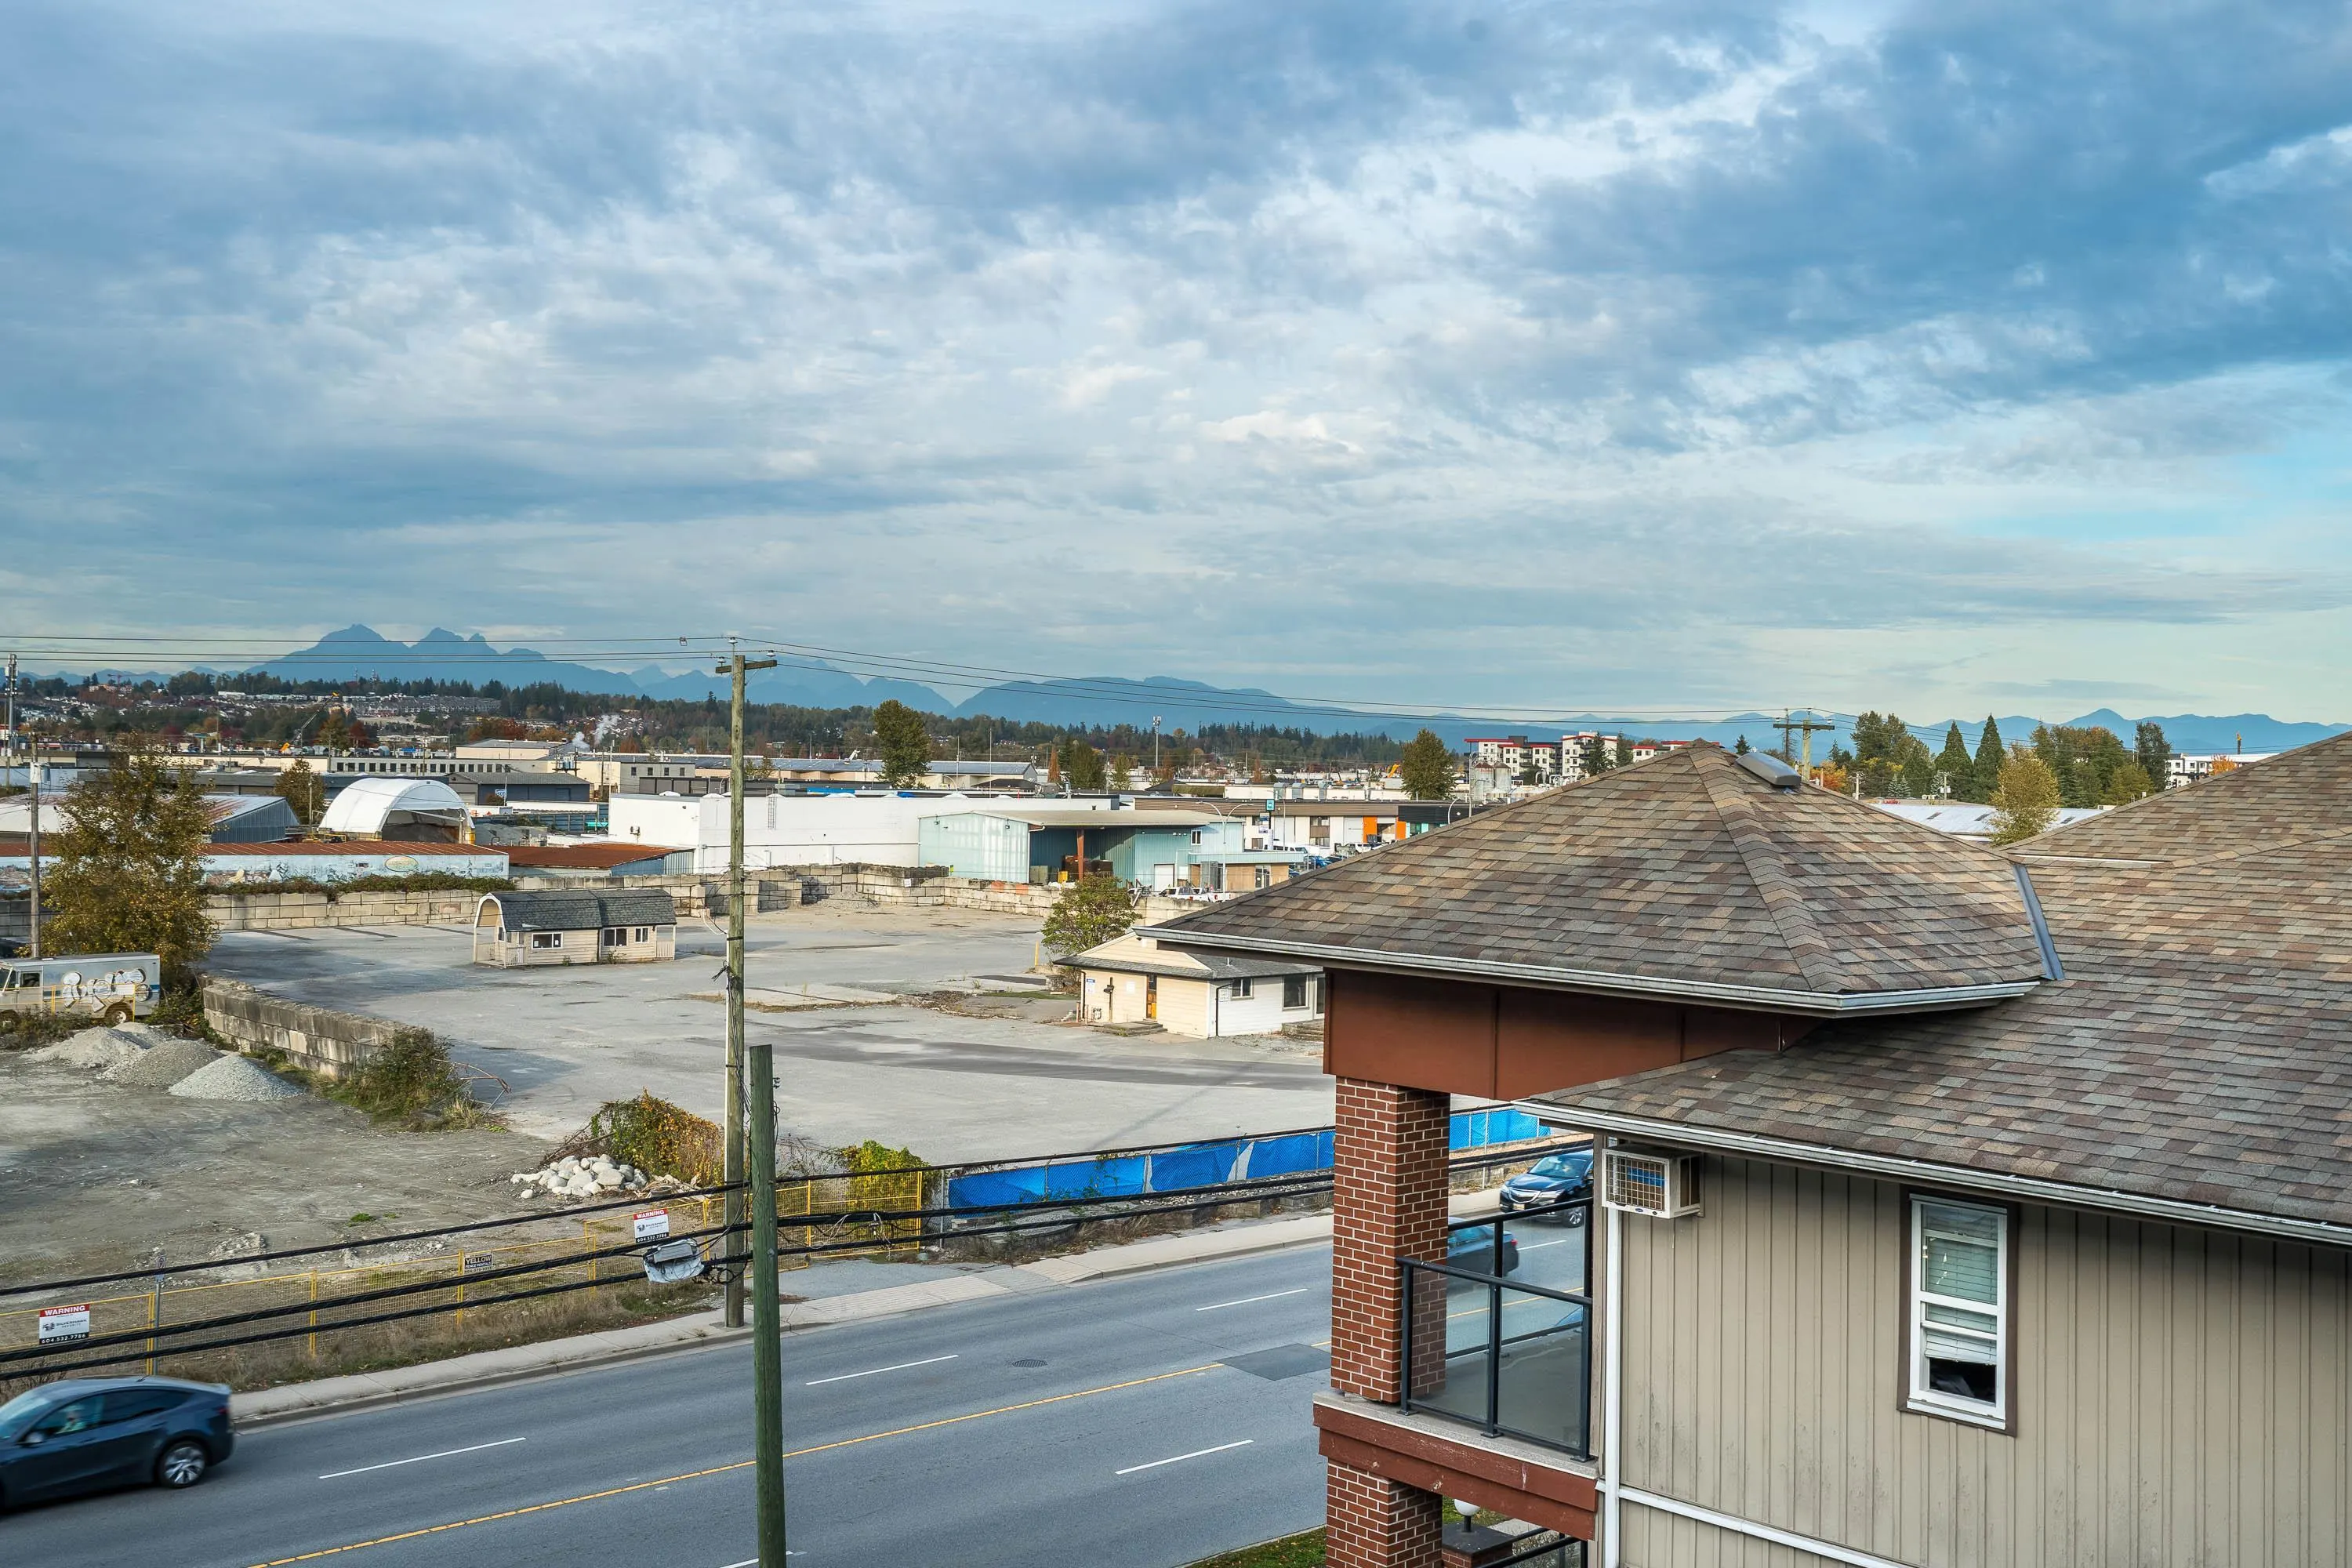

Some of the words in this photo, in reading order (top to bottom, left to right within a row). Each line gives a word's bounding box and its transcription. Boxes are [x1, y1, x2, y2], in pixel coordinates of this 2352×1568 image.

[637, 1210, 665, 1219] WARNING
[466, 1255, 492, 1264] YELLOW
[45, 1305, 86, 1316] WARNING
